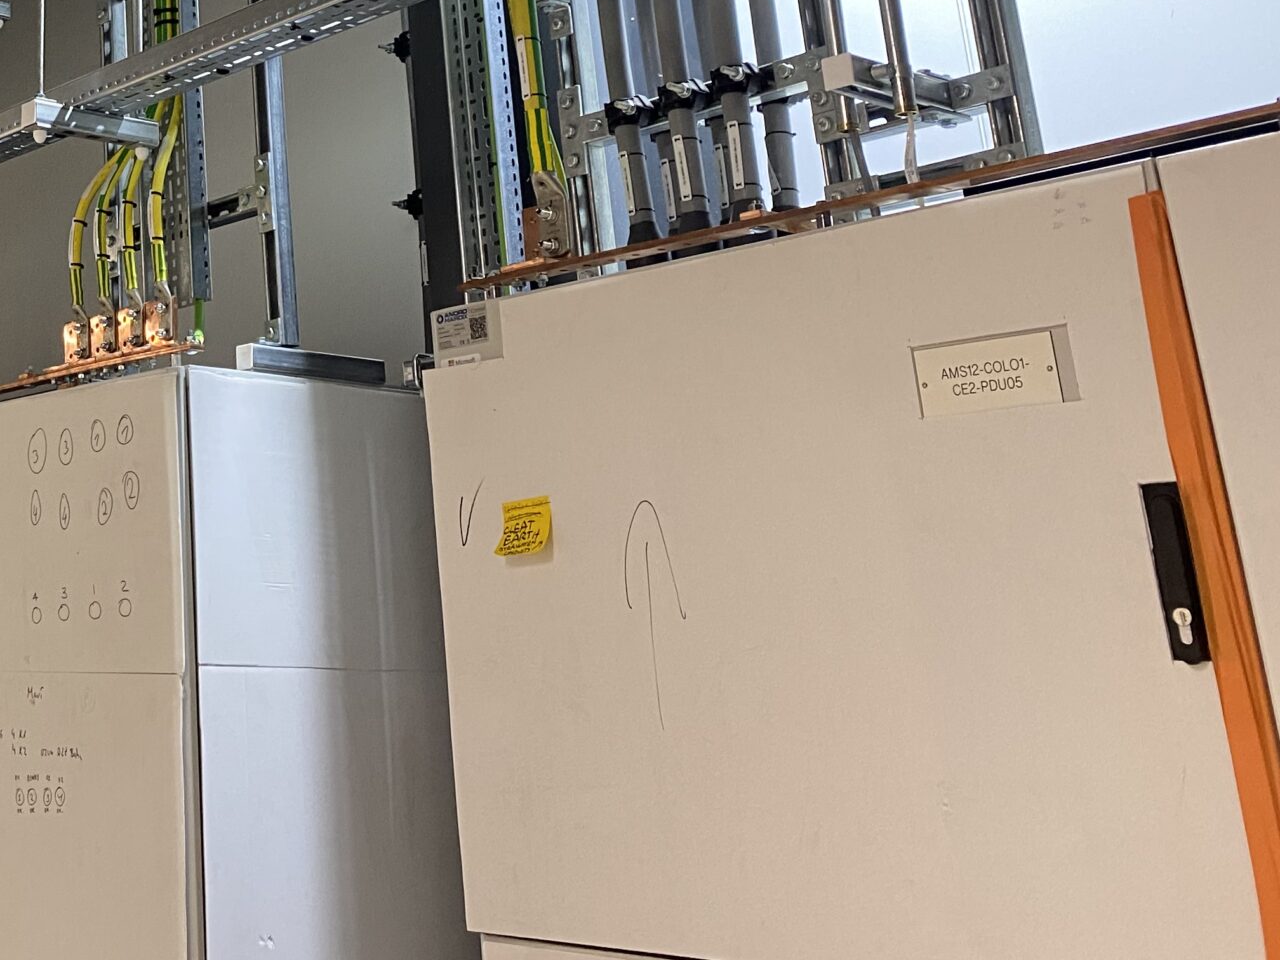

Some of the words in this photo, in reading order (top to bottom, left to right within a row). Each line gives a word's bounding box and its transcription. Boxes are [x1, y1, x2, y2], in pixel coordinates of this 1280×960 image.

[952, 375, 1024, 397] CE2-PDU05
[503, 528, 541, 547] EARTH
[61, 586, 68, 600] 3
[120, 580, 129, 593] 2
